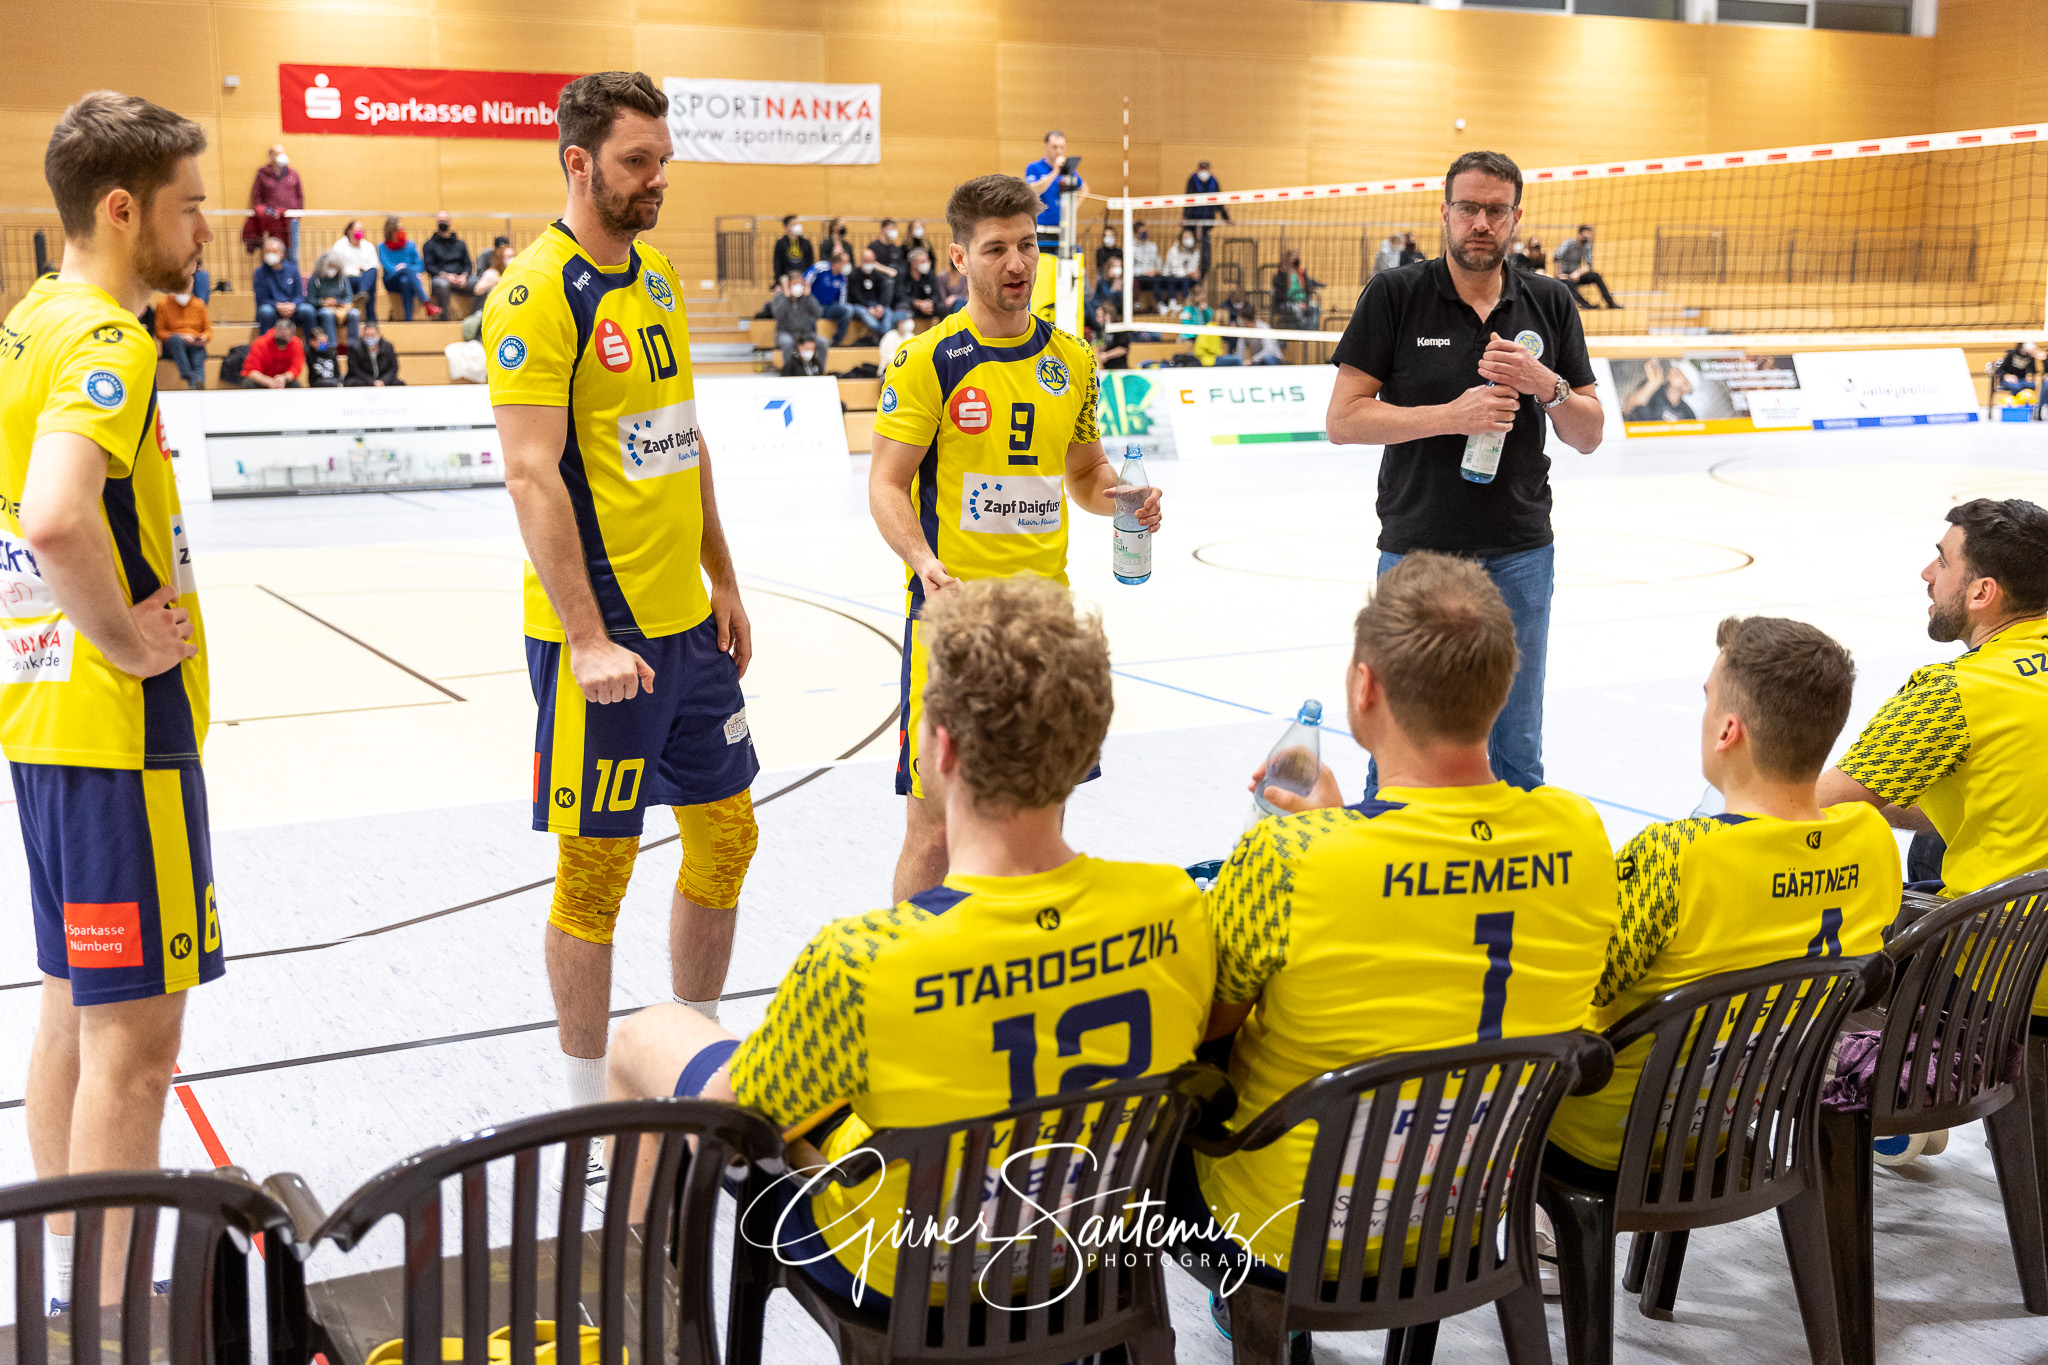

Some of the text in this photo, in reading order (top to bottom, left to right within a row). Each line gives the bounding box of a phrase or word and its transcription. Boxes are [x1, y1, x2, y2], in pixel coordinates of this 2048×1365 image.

[354, 96, 477, 126] Sparkasse
[673, 94, 873, 121] SPORTNANKA
[673, 124, 874, 148] www.sportnanka.de
[637, 324, 678, 383] 10
[946, 343, 974, 359] Kempa
[1416, 337, 1451, 347] Kempa
[1209, 386, 1305, 404] FUCHS
[1009, 403, 1035, 450] 9
[642, 434, 675, 454] Zapf
[983, 499, 1017, 516] Zapf
[592, 758, 645, 812] 10
[1382, 851, 1573, 897] KLEMENT
[1772, 863, 1859, 898] GÄRTNER
[69, 924, 125, 937] Sparkasse
[204, 882, 221, 953] 6
[70, 940, 123, 953] Nürnberg
[914, 919, 1178, 1014] STAROSCZIK
[1473, 910, 1515, 1041] 1
